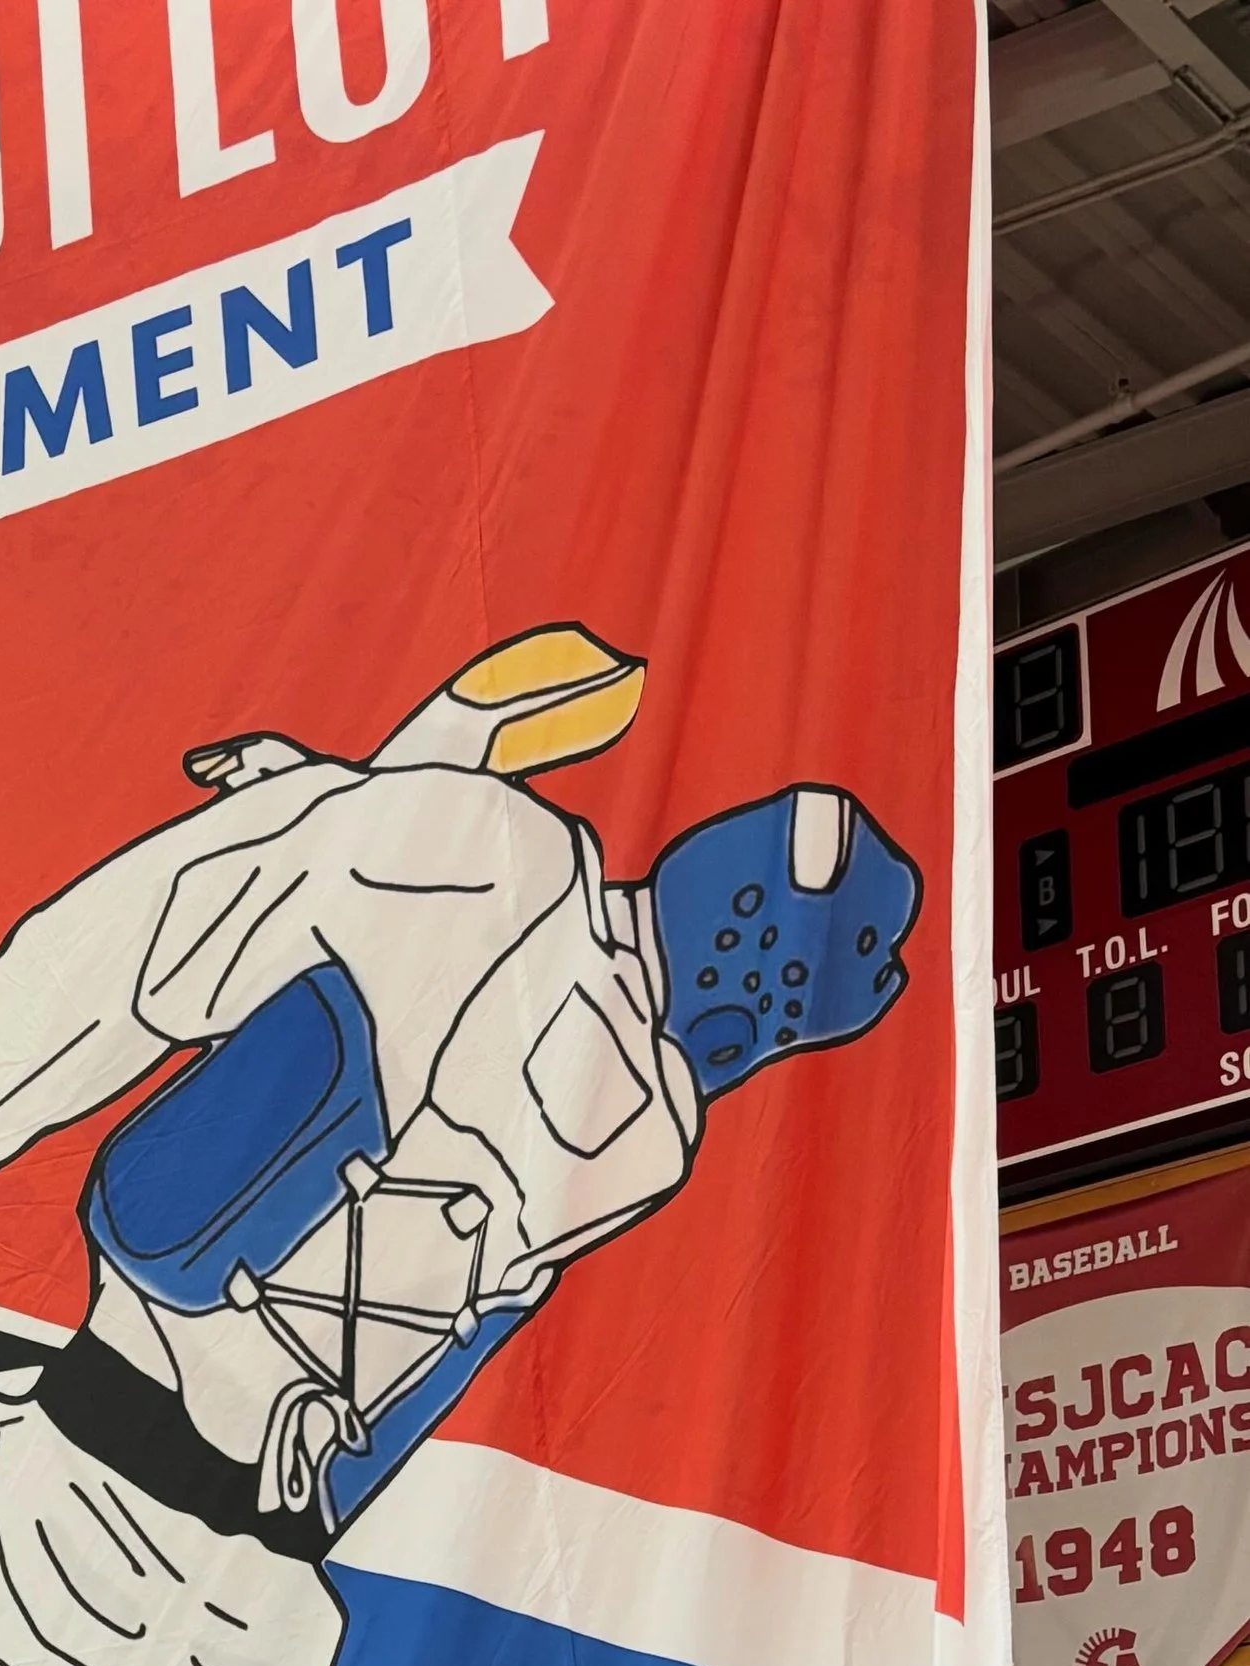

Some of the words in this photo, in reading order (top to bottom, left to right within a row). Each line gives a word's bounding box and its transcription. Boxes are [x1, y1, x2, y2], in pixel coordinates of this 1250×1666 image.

[1076, 927, 1168, 978] T.O.L.
[1008, 1224, 1179, 1291] BASEBALL
[1002, 1325, 1250, 1442] SJCAC
[1015, 1504, 1197, 1604] 1948
